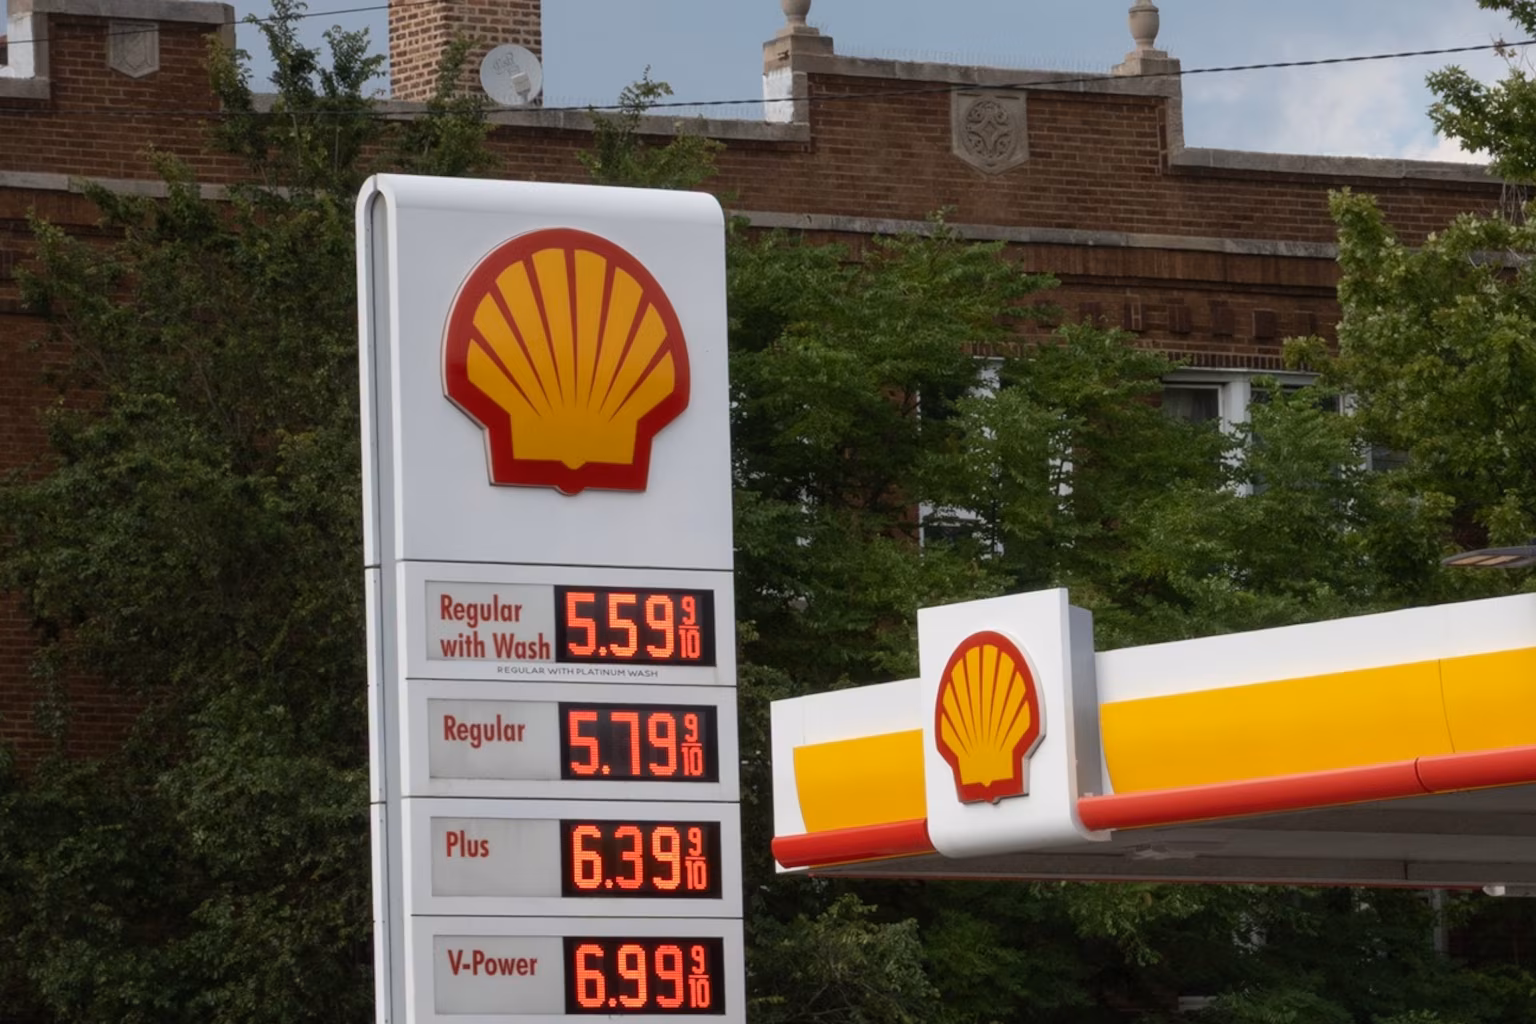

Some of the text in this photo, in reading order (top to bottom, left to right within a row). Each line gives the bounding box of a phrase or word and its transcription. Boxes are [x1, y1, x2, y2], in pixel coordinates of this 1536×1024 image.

[440, 594, 522, 628] Regular
[566, 591, 674, 658] 5.59
[440, 630, 550, 660] with Wash
[497, 666, 659, 678] REGULAR WITH PLATINUM WASH
[443, 714, 525, 748] Regular
[568, 710, 677, 776] 5.79
[446, 830, 490, 858] Plus
[572, 825, 681, 890] 6.39
[447, 949, 538, 976] V-Power
[575, 943, 684, 1008] 6.99
